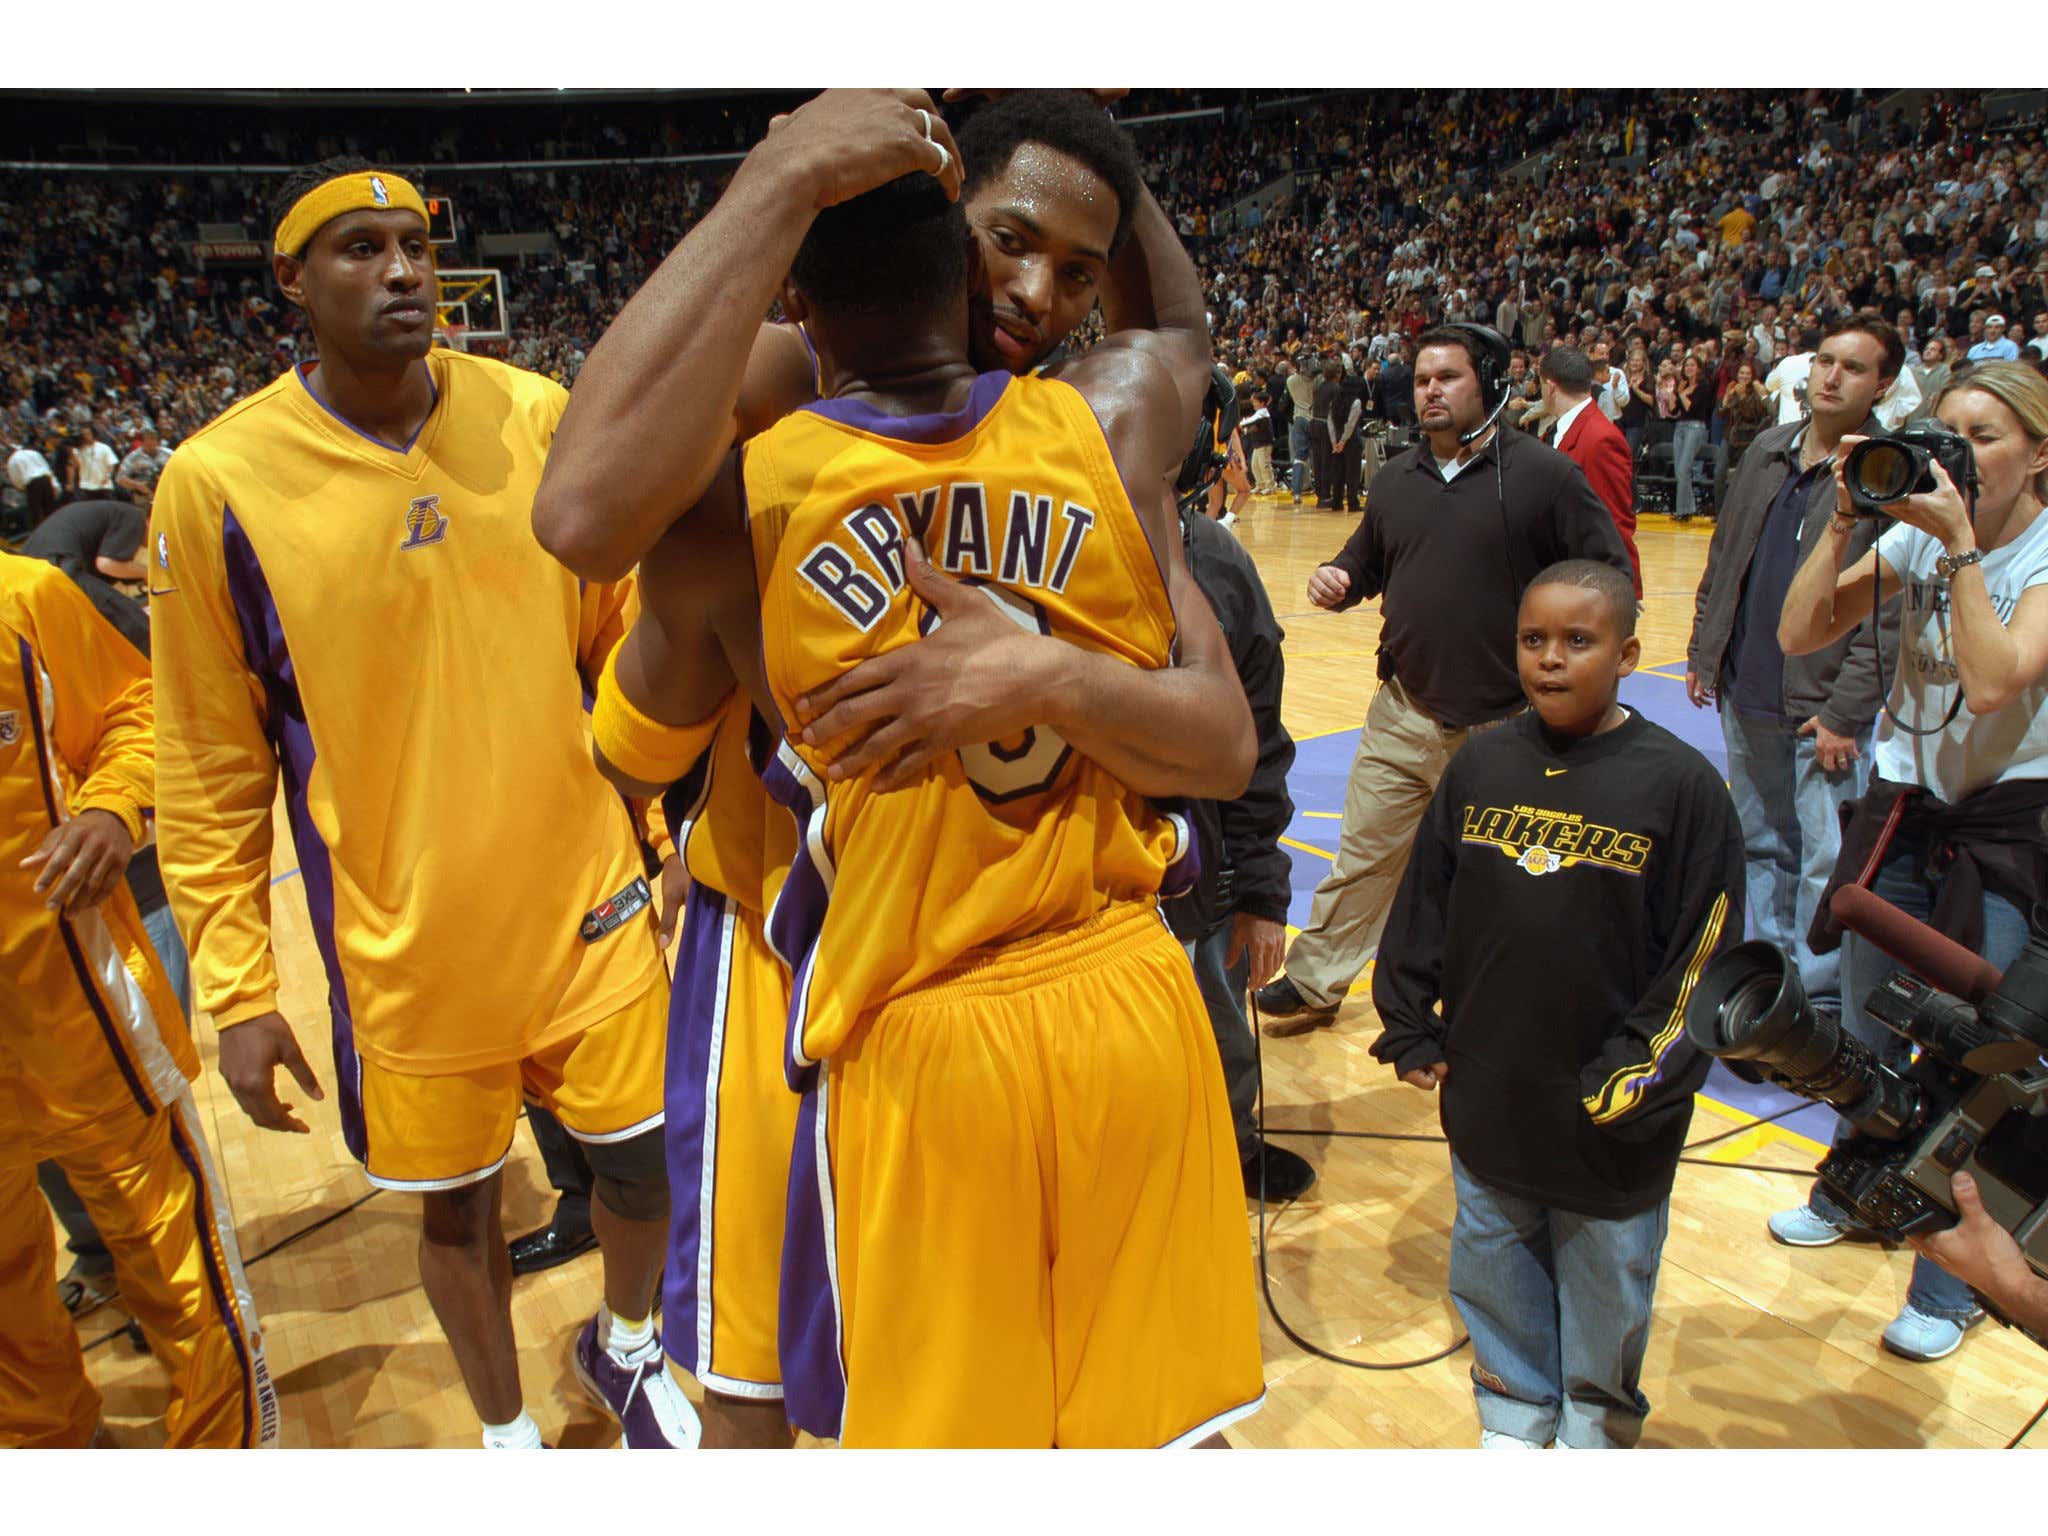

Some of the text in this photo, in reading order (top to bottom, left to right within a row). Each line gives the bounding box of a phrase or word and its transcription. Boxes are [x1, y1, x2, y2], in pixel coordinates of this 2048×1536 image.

[213, 245, 262, 256] TOYOTA
[797, 481, 1095, 633] BRYANT
[1463, 805, 1652, 869] LAKERS
[1513, 804, 1536, 814] LOS
[254, 1357, 277, 1443] LOS ANGELES
